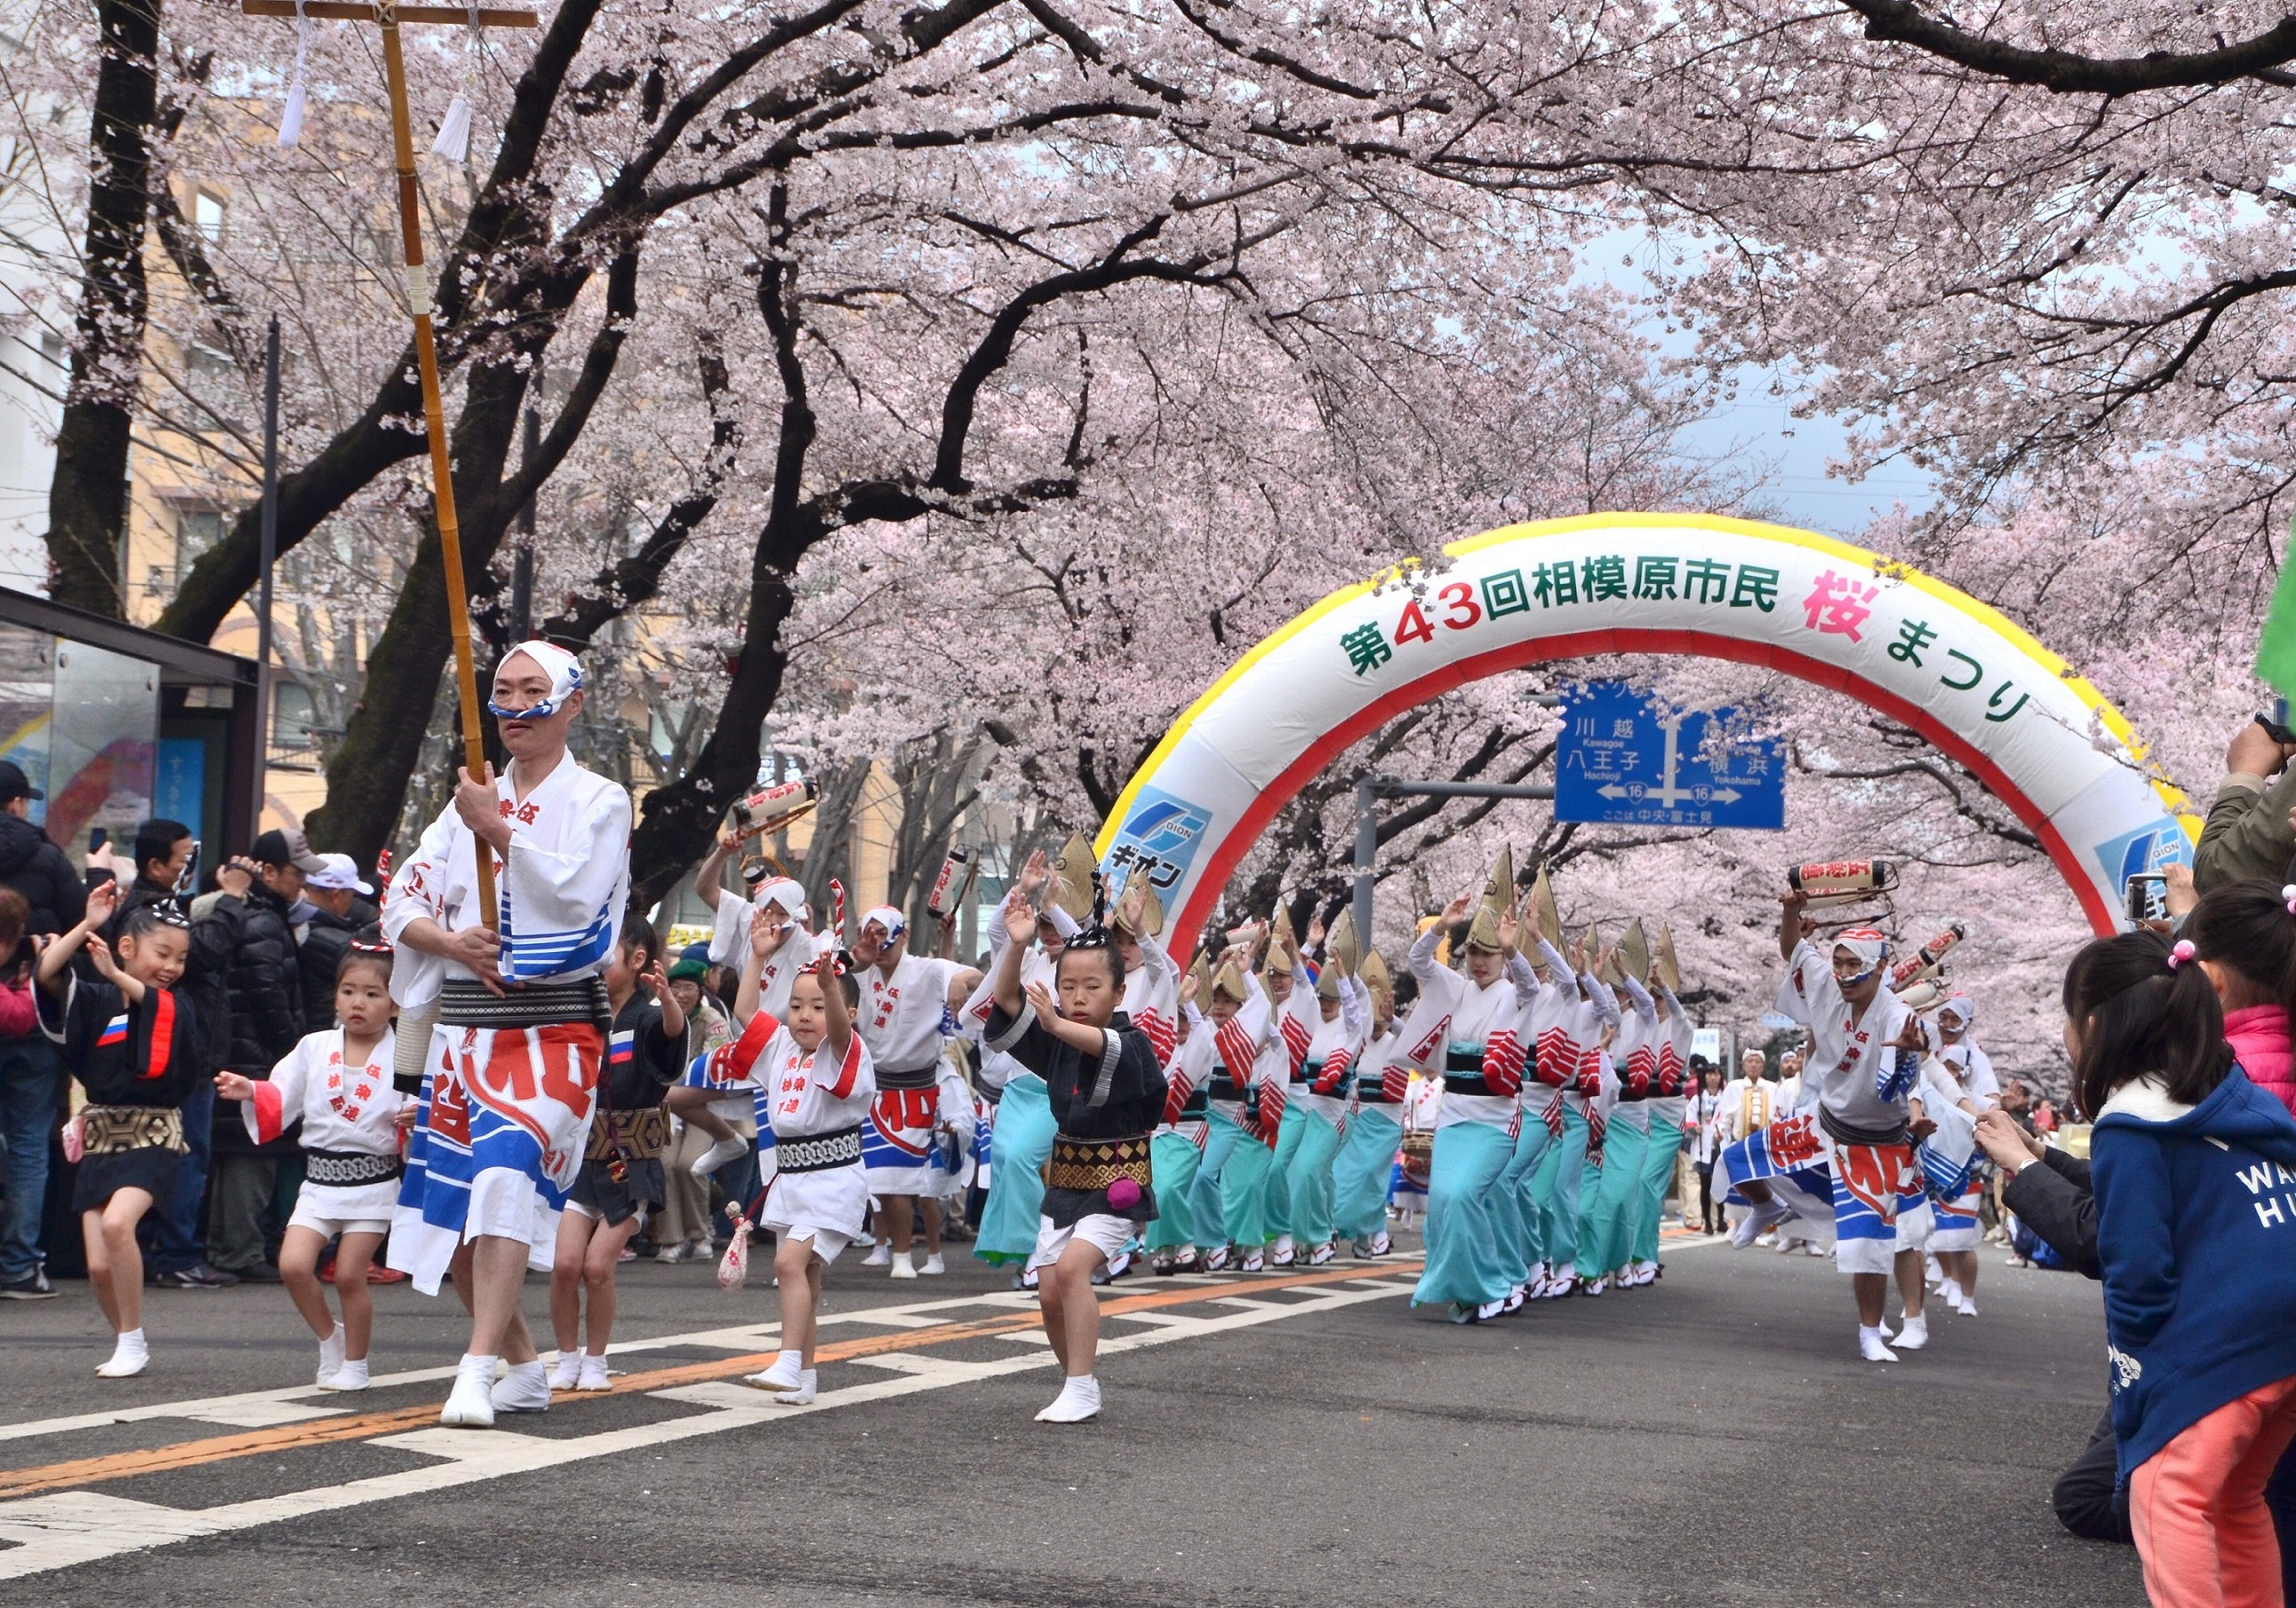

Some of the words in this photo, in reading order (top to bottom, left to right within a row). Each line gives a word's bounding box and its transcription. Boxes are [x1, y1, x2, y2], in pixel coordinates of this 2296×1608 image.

[1575, 717, 1633, 738] 川越
[1582, 738, 1625, 749] Kawagoe
[1566, 749, 1639, 771] 八王子
[1583, 771, 1621, 782] Hachioji
[1714, 776, 1762, 786] Yokohama
[1628, 784, 1643, 797] 16
[1694, 787, 1709, 800] 16
[1602, 810, 1635, 820] ここは
[1165, 822, 1193, 839] GION
[2152, 842, 2180, 858] GION
